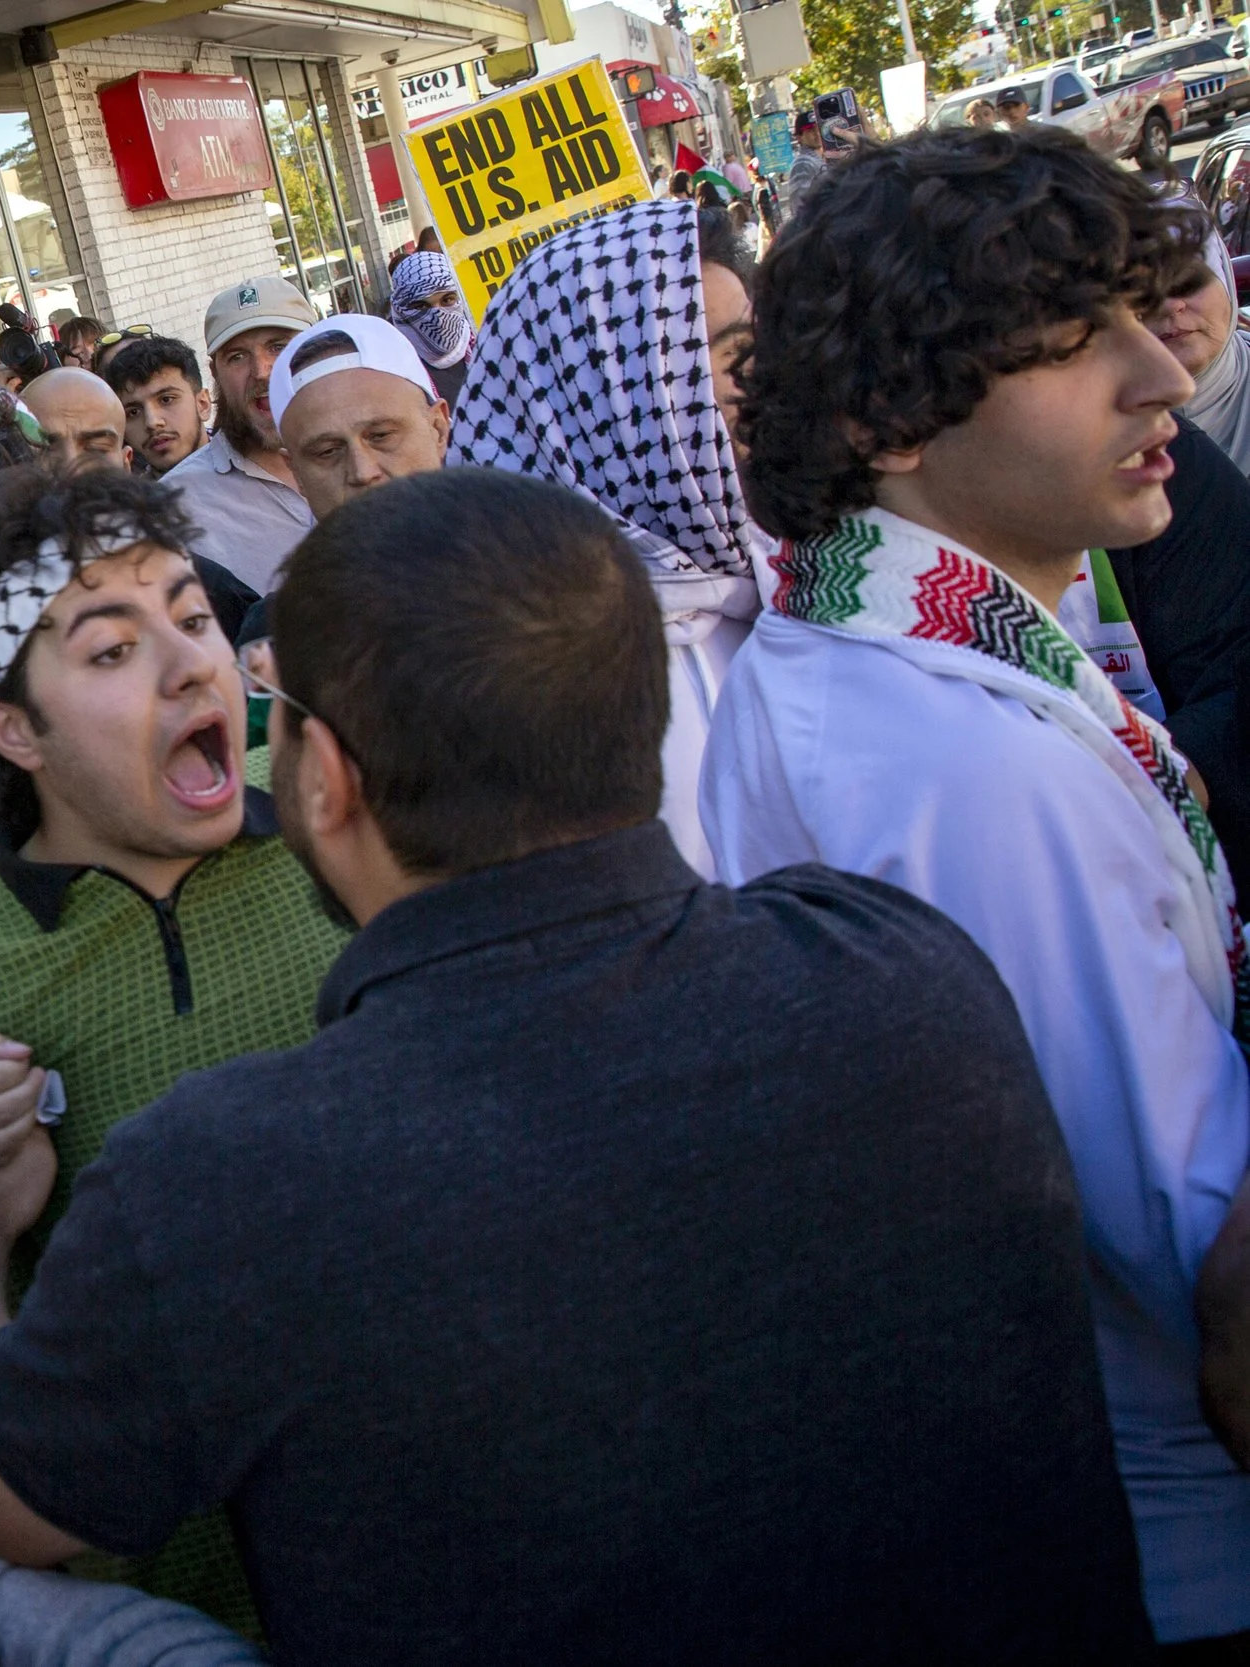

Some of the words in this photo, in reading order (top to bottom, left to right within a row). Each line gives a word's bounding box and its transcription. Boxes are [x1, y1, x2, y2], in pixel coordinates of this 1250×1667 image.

[162, 98, 189, 120] BANK
[404, 91, 453, 108] ENTRAL
[422, 108, 515, 186] END
[520, 74, 608, 149] ALL
[199, 135, 237, 178] ATM
[445, 167, 541, 236] U.S.
[542, 129, 620, 203] AID
[469, 246, 505, 282] TO
